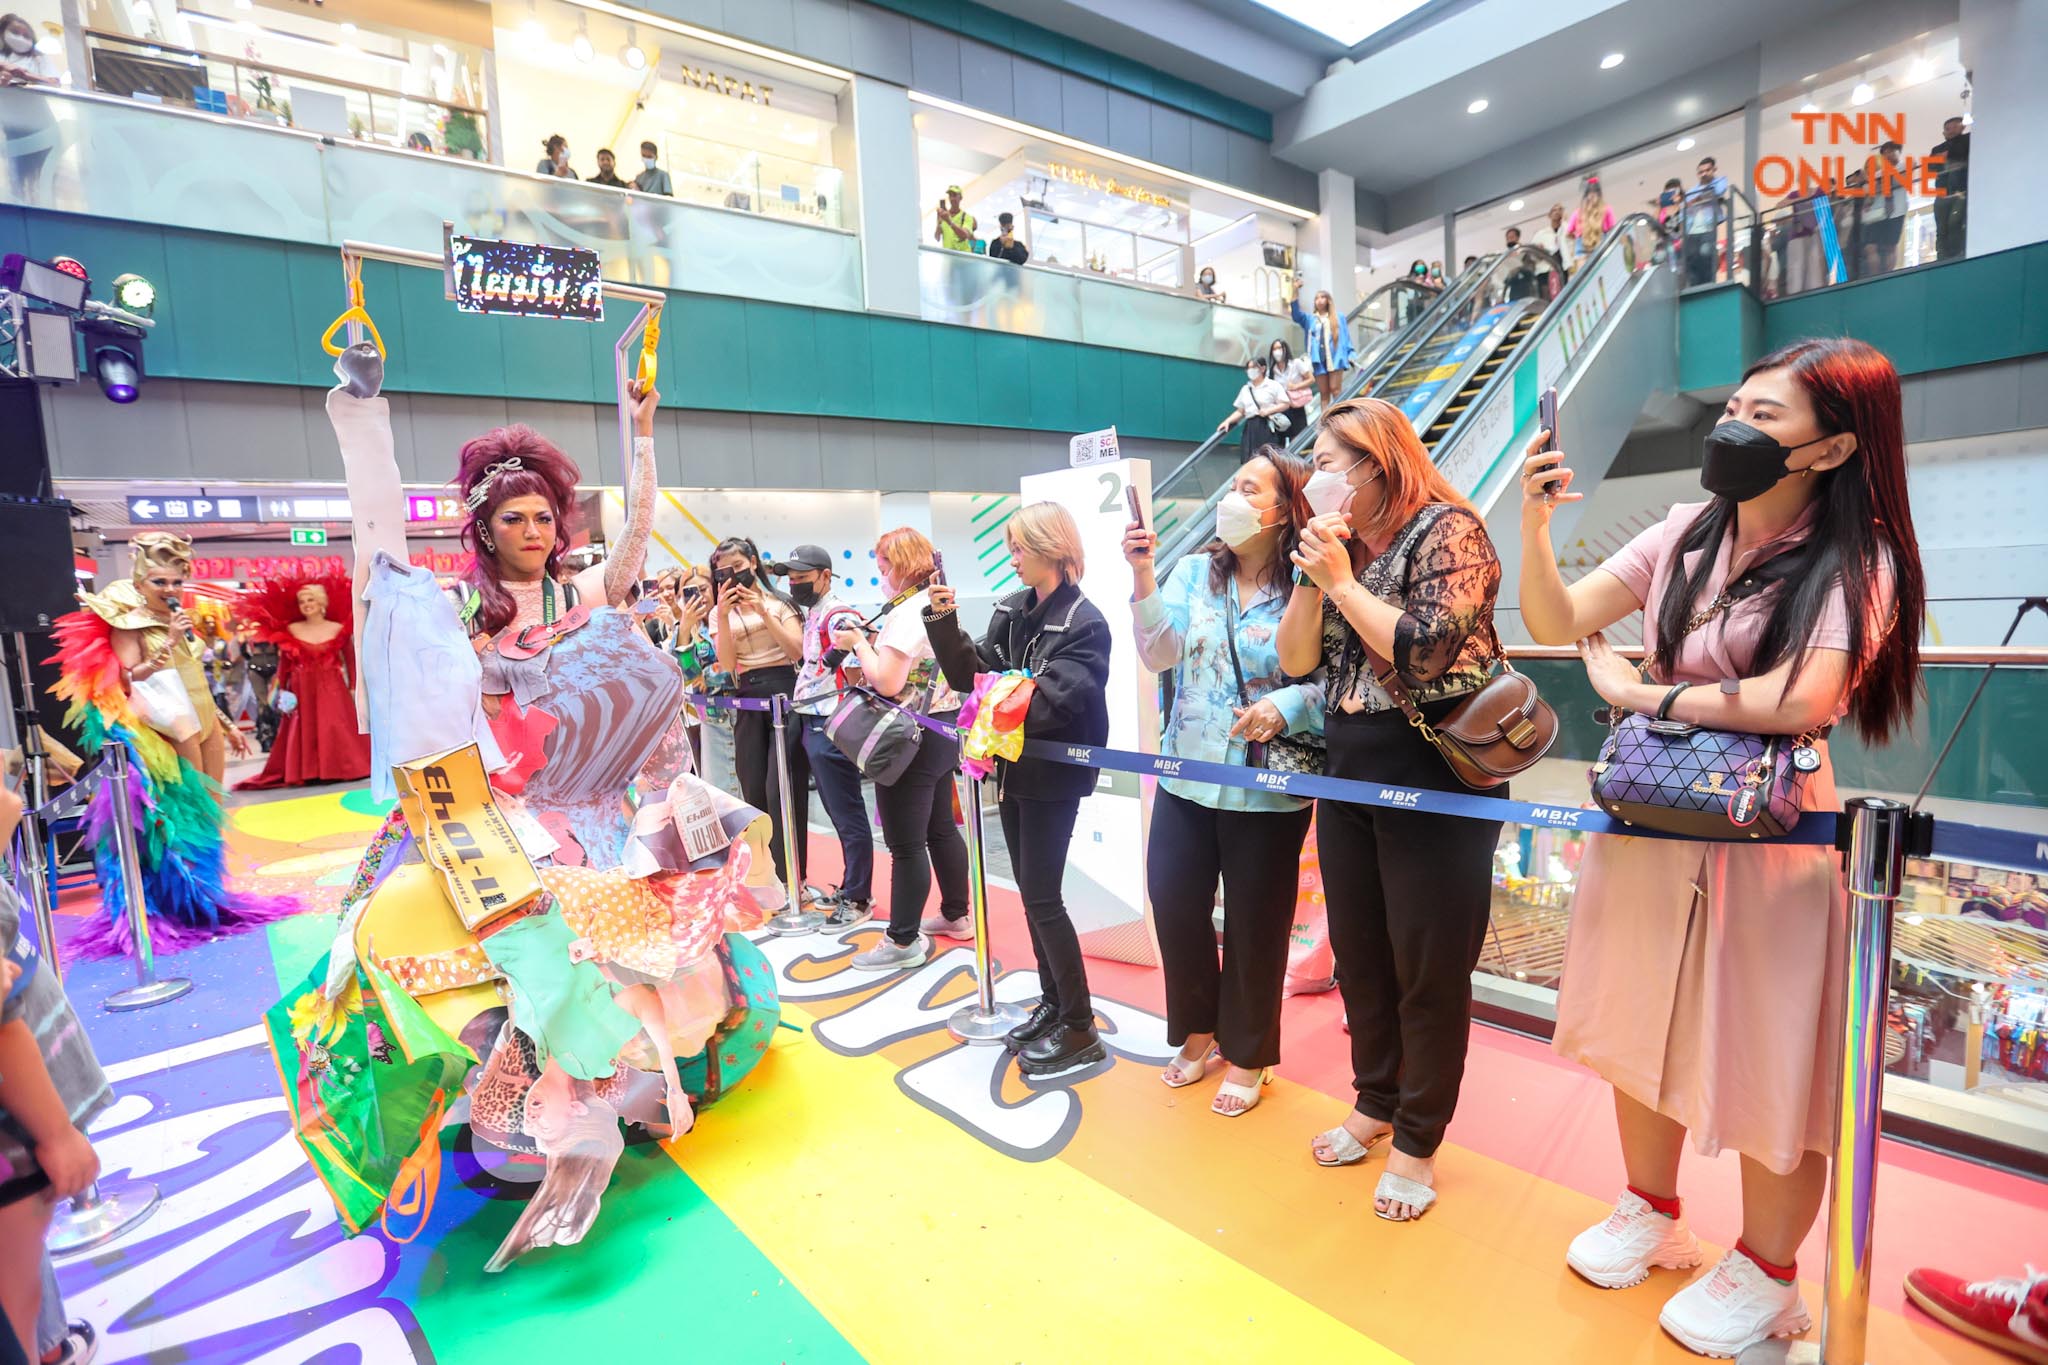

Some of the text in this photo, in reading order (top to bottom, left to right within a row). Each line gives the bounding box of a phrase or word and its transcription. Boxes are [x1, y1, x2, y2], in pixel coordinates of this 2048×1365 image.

[682, 65, 774, 106] NAPAT
[1100, 447, 1117, 457] ME!
[1098, 472, 1122, 513] 2
[193, 500, 213, 517] P
[1067, 747, 1091, 759] MBK
[1153, 759, 1183, 771] MBK
[1256, 773, 1292, 786] MBK
[1379, 789, 1422, 803] MBK
[1531, 807, 1584, 822] MBK
[482, 801, 518, 855] BANGKOK
[1547, 819, 1577, 827] CENTER
